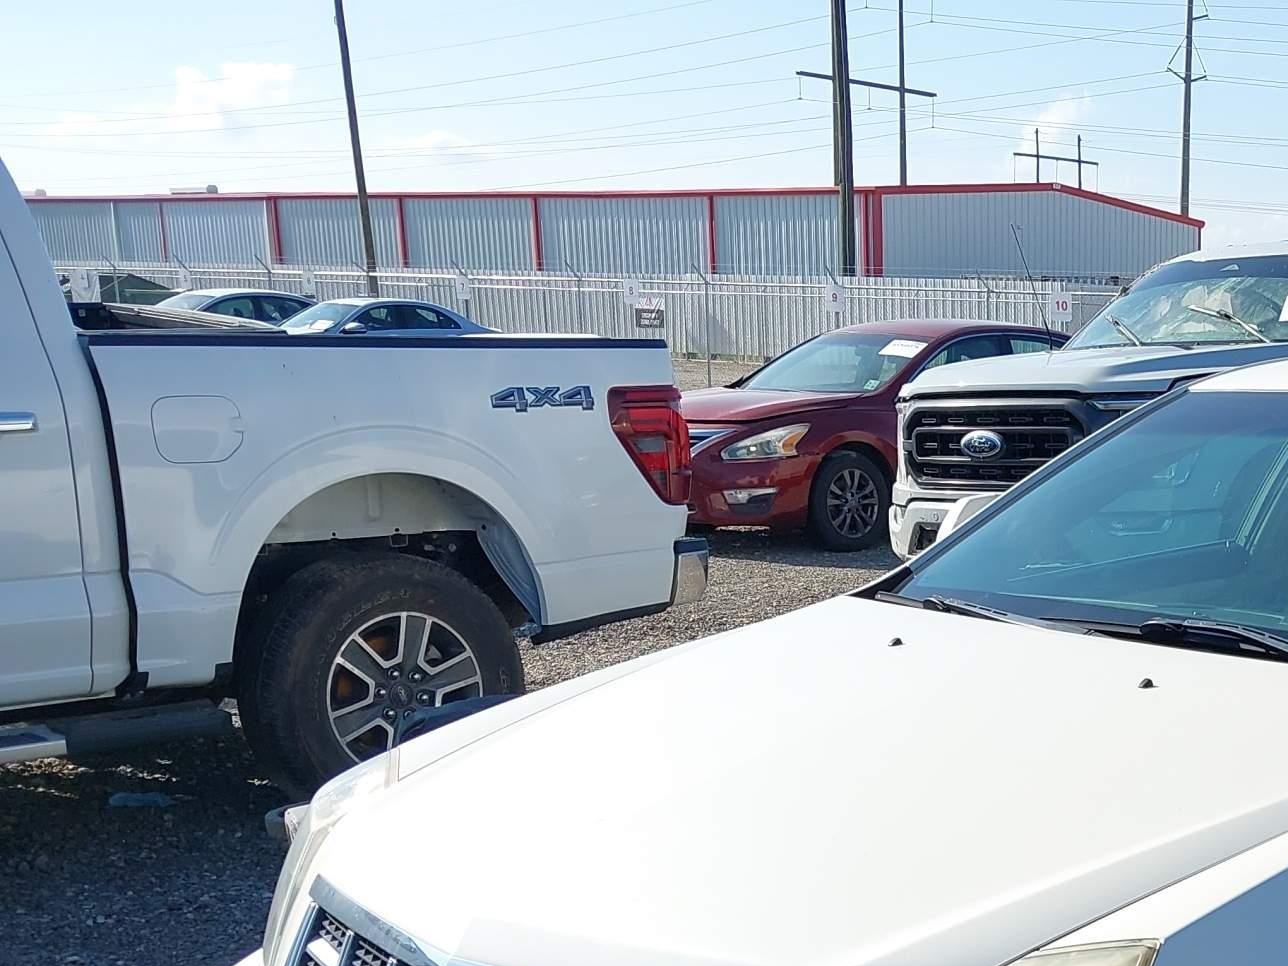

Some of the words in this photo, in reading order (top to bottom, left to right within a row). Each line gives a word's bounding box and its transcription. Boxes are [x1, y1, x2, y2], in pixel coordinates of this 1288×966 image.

[628, 286, 635, 296] 8
[831, 292, 838, 303] 9
[1055, 300, 1068, 312] 10
